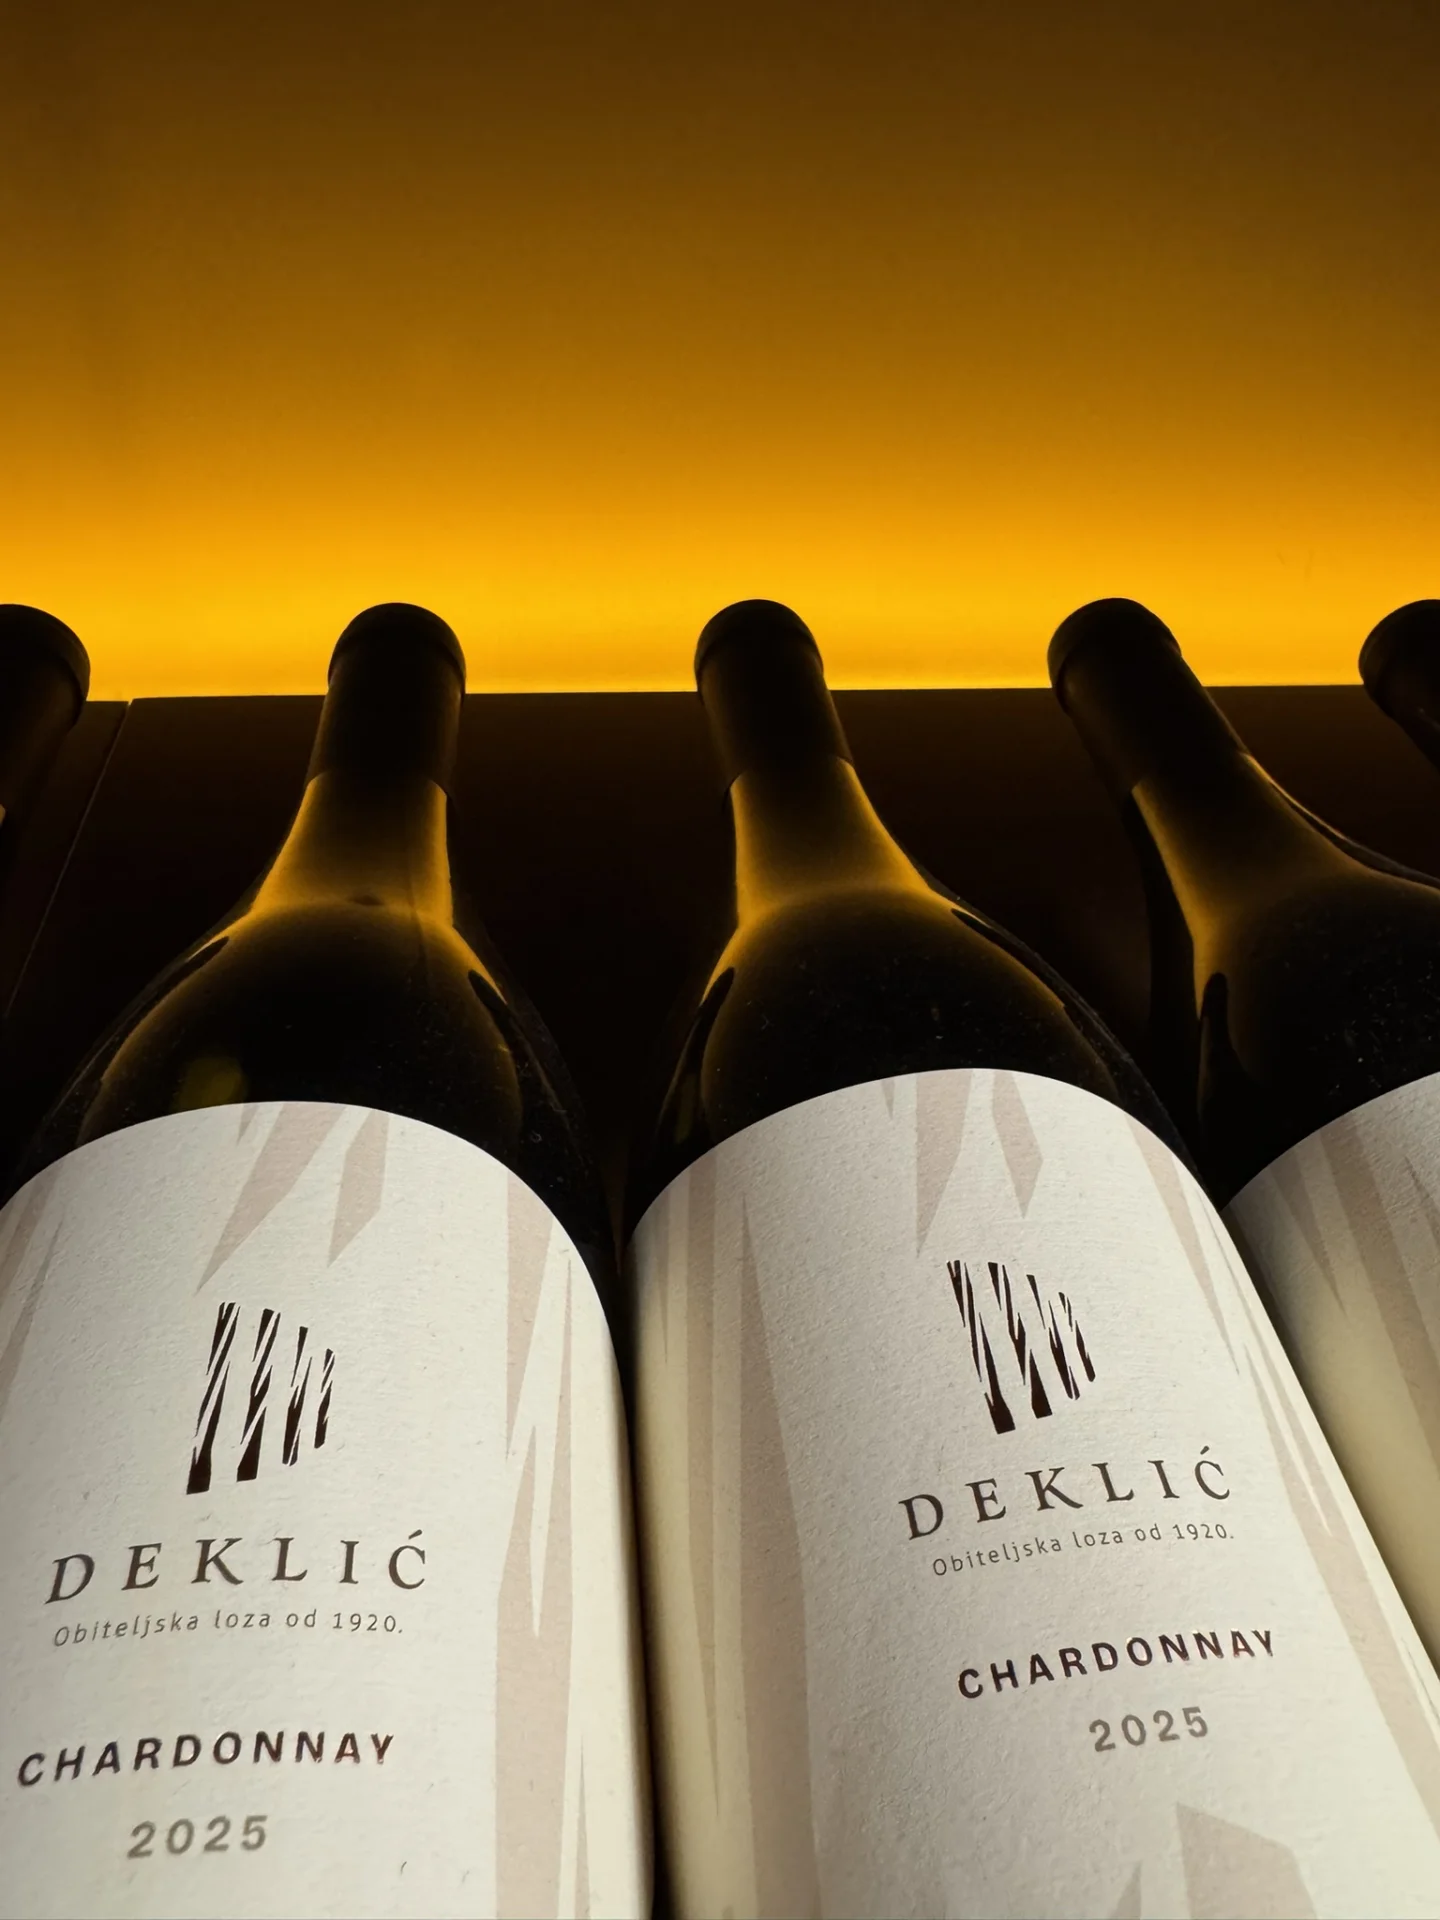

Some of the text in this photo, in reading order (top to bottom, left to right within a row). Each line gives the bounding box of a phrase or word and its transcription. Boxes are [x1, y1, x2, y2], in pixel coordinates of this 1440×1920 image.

[899, 1446, 1231, 1540] DEKLIĆ
[45, 1530, 427, 1604] DEKLIĆ
[932, 1522, 1235, 1577] Obiteljska loza od 1920.
[53, 1609, 404, 1647] Obiteljska loza od 1920.
[957, 1628, 1276, 1699] CHARDONNAY
[1088, 1705, 1209, 1753] 2025
[17, 1730, 395, 1787] CHARDONNAY
[127, 1814, 269, 1859] 2025
